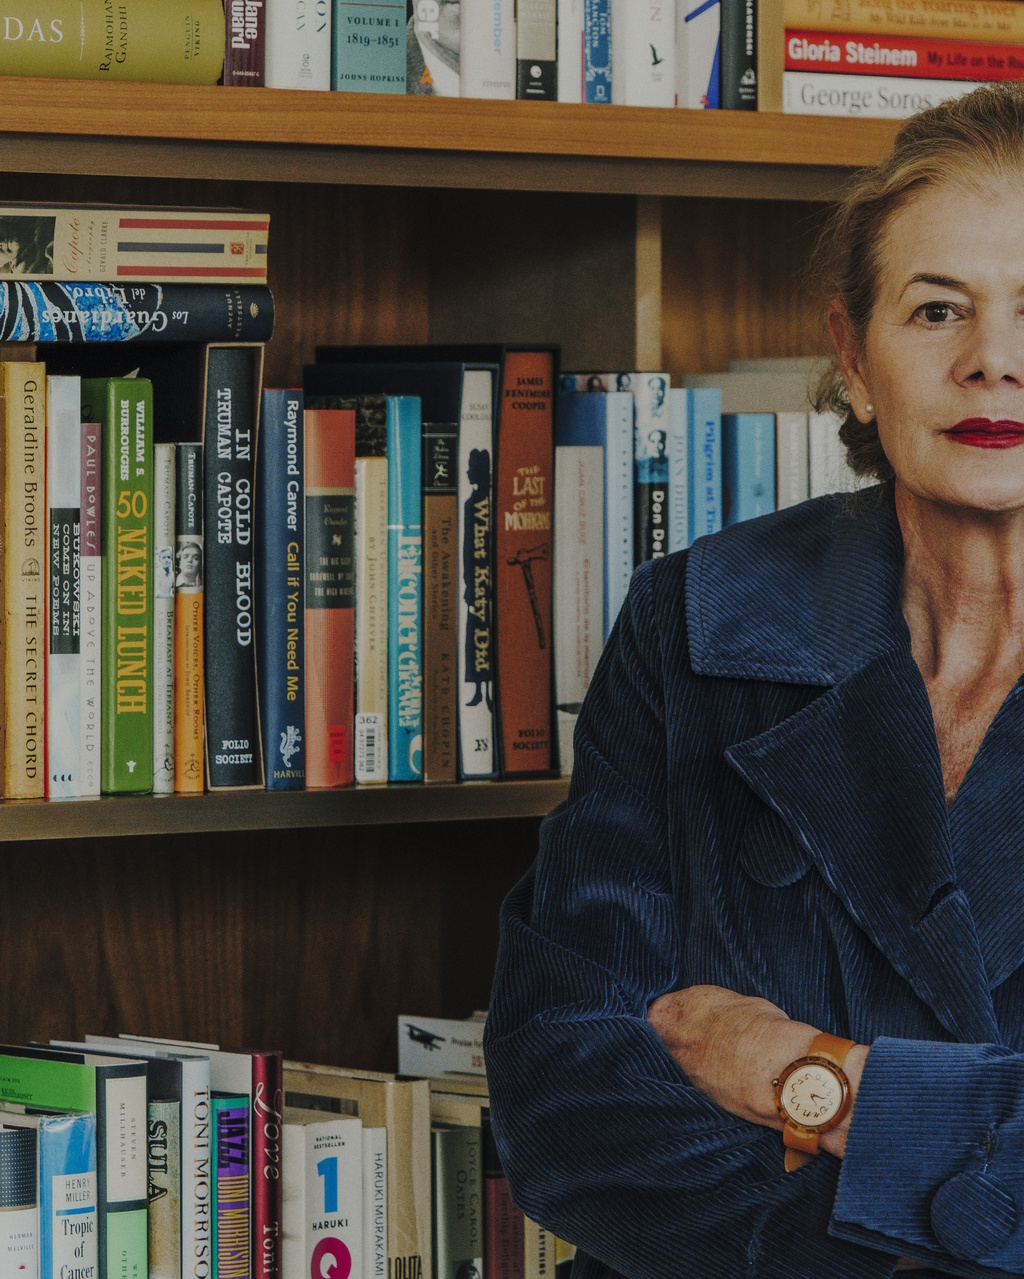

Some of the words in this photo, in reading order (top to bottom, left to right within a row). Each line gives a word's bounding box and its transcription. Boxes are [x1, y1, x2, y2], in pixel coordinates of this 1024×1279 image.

[3, 16, 64, 42] DAS
[115, 5, 127, 64] GANDHI
[788, 37, 841, 62] Gloria
[845, 41, 917, 67] Steinem
[61, 217, 83, 273] Capote
[42, 311, 168, 331] Guardianes
[172, 311, 189, 324] Los
[22, 380, 37, 474] Geraldine
[120, 399, 130, 481] BURROUGHS
[135, 401, 145, 464] WILLIAM
[217, 388, 232, 461] TRUMAN
[235, 428, 250, 461] IN
[285, 401, 299, 476] Raymond
[22, 480, 37, 547] Brooks
[116, 490, 147, 519] 50
[217, 472, 232, 544] CAPOTE
[235, 477, 250, 546] COLD
[285, 480, 299, 532] Carver
[73, 522, 81, 636] BUKOWSKI
[116, 525, 146, 616] NAKED
[286, 541, 300, 572] Call
[286, 577, 300, 590] if
[25, 595, 37, 628] THE
[236, 561, 251, 646] BLOOD
[286, 594, 300, 624] You
[25, 635, 37, 703] SECRET
[116, 624, 146, 715] LUNCH
[286, 629, 300, 673] Need
[286, 677, 300, 701] Me
[25, 709, 37, 779] CHORD
[193, 1085, 209, 1148] TONI
[218, 1110, 248, 1167] JAZZ
[254, 1082, 282, 1180] Love
[66, 1179, 90, 1190] HENRY
[148, 1120, 168, 1204] SULA
[317, 1156, 338, 1213] 1
[375, 1152, 383, 1200] HARUKI
[66, 1191, 90, 1202] MILLER
[312, 1219, 348, 1230] HARUKI
[61, 1217, 93, 1236] Tropic
[74, 1242, 85, 1258] of
[375, 1204, 383, 1275] MURAKAMI
